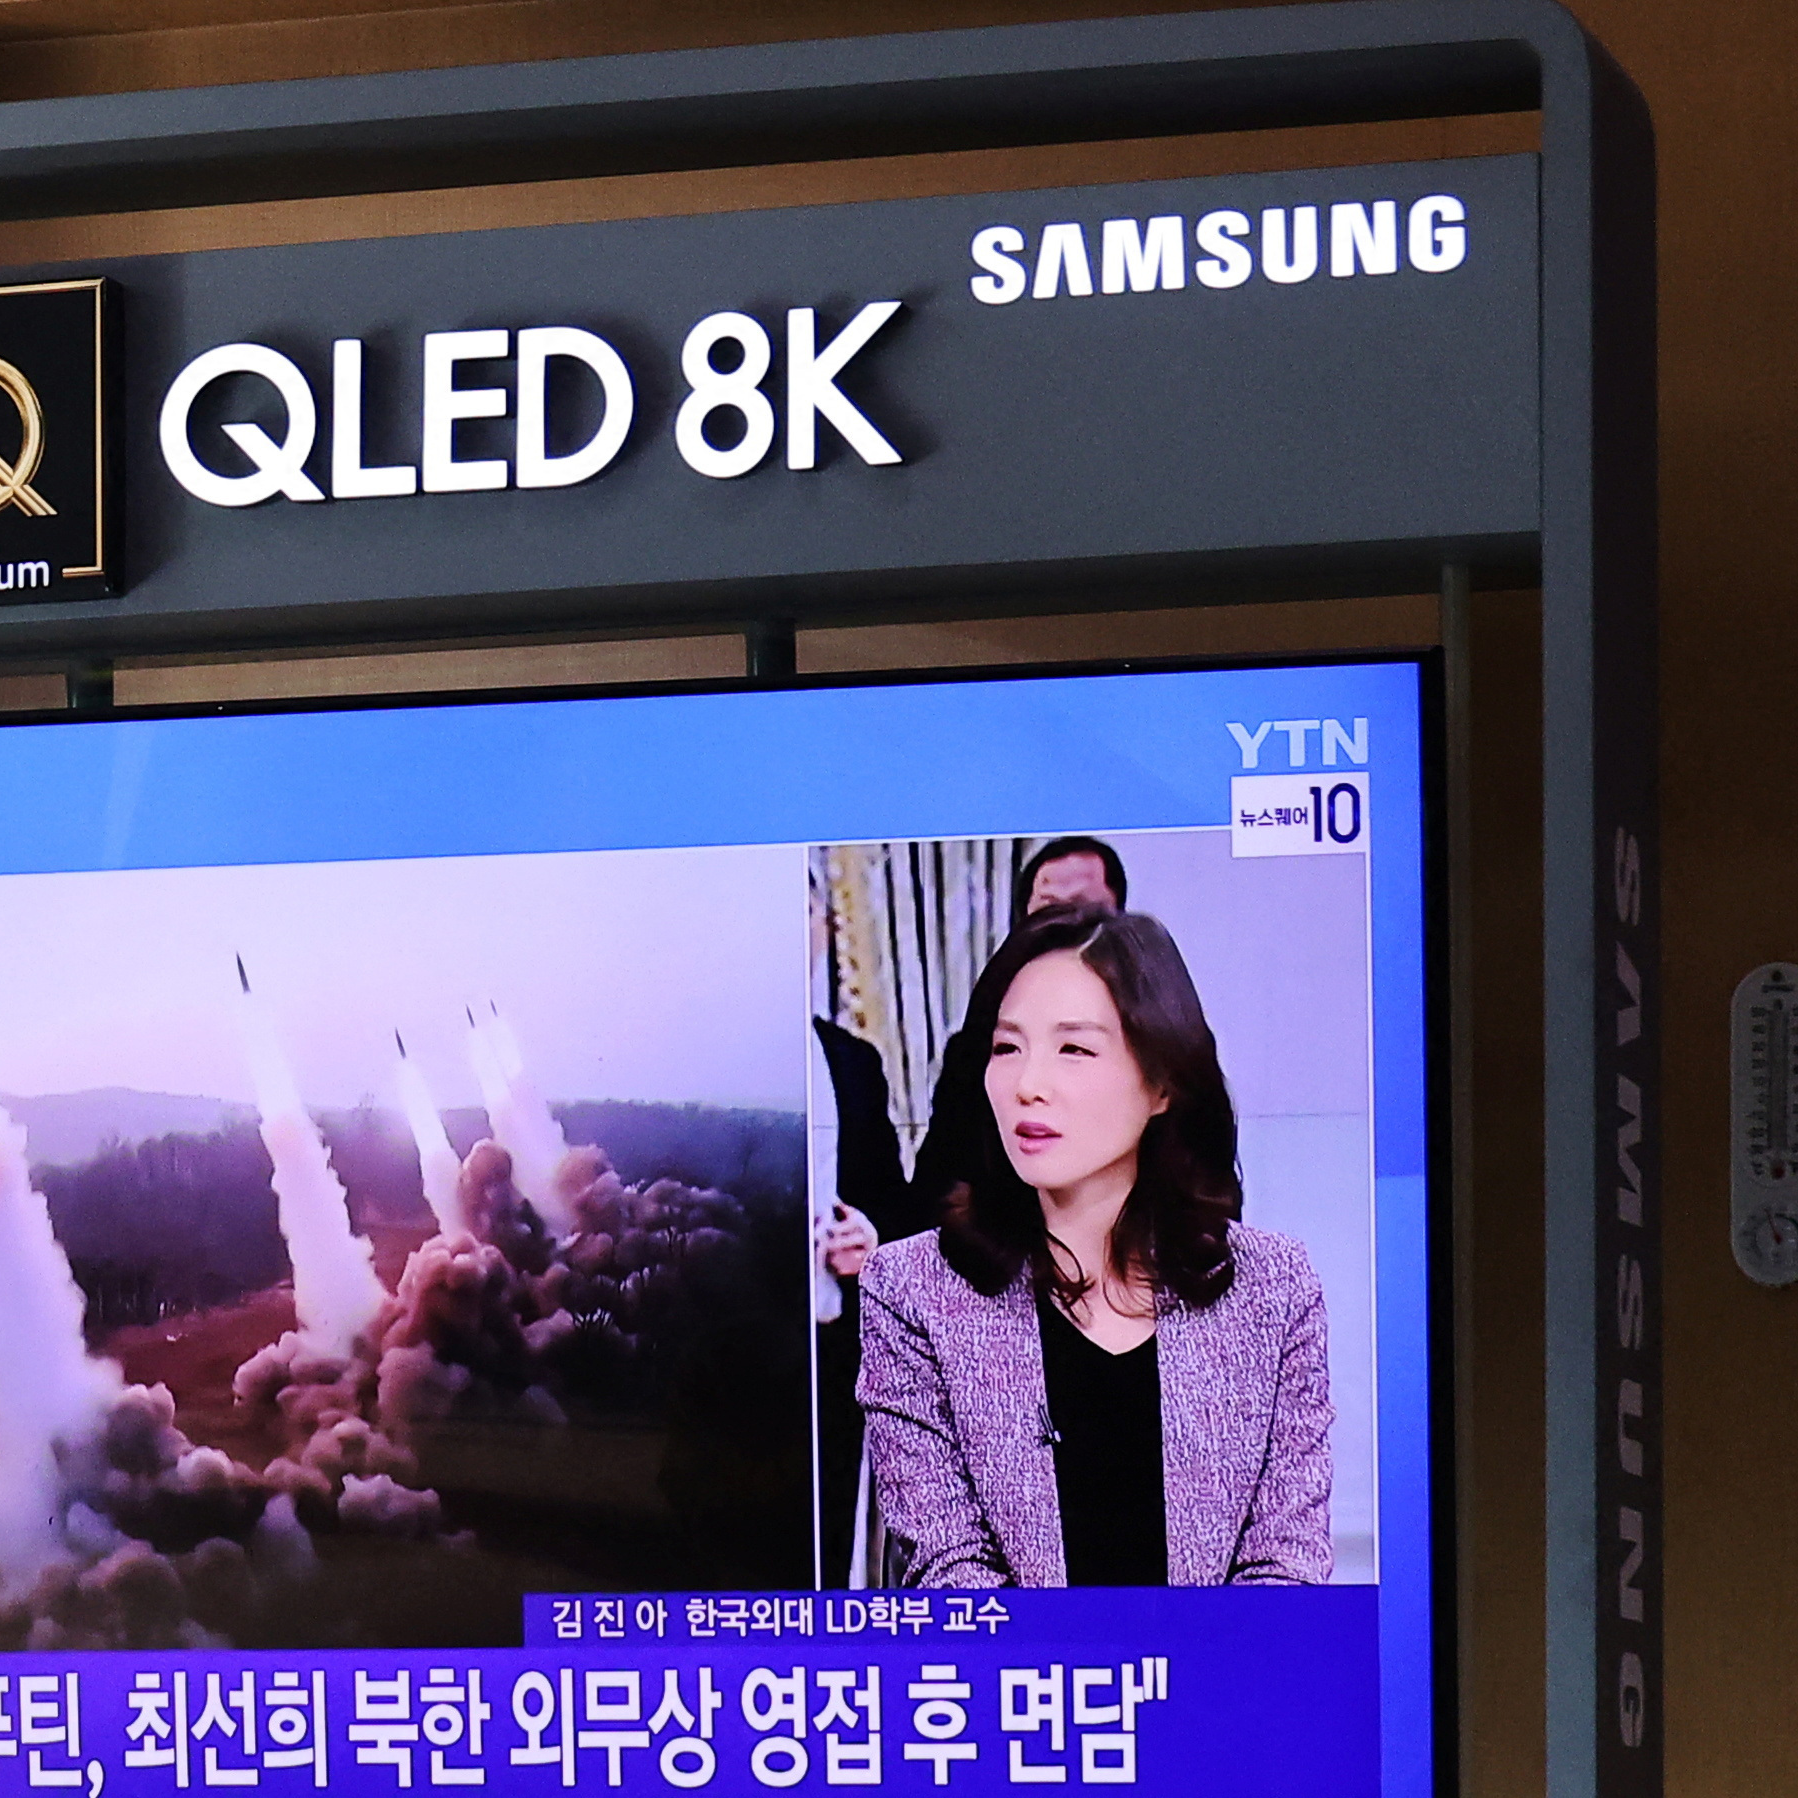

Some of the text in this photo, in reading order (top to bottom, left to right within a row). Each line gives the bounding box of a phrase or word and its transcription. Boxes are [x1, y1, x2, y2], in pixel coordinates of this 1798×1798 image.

[972, 194, 1468, 308] SAMSUNG
[159, 300, 903, 508] QLED 8K
[1225, 717, 1368, 769] YTN
[1309, 782, 1361, 844] 10
[1614, 826, 1644, 1750] SAMSUNG
[684, 1598, 815, 1637] 한국외대
[825, 1597, 934, 1635] LD학부
[942, 1596, 1011, 1634] 교수
[124, 1669, 328, 1789] 최선희
[347, 1667, 491, 1789] 북한
[509, 1666, 723, 1788] 외무상
[740, 1664, 882, 1788] 영접
[904, 1663, 978, 1786] 후
[1000, 1656, 1169, 1785] 면담"
